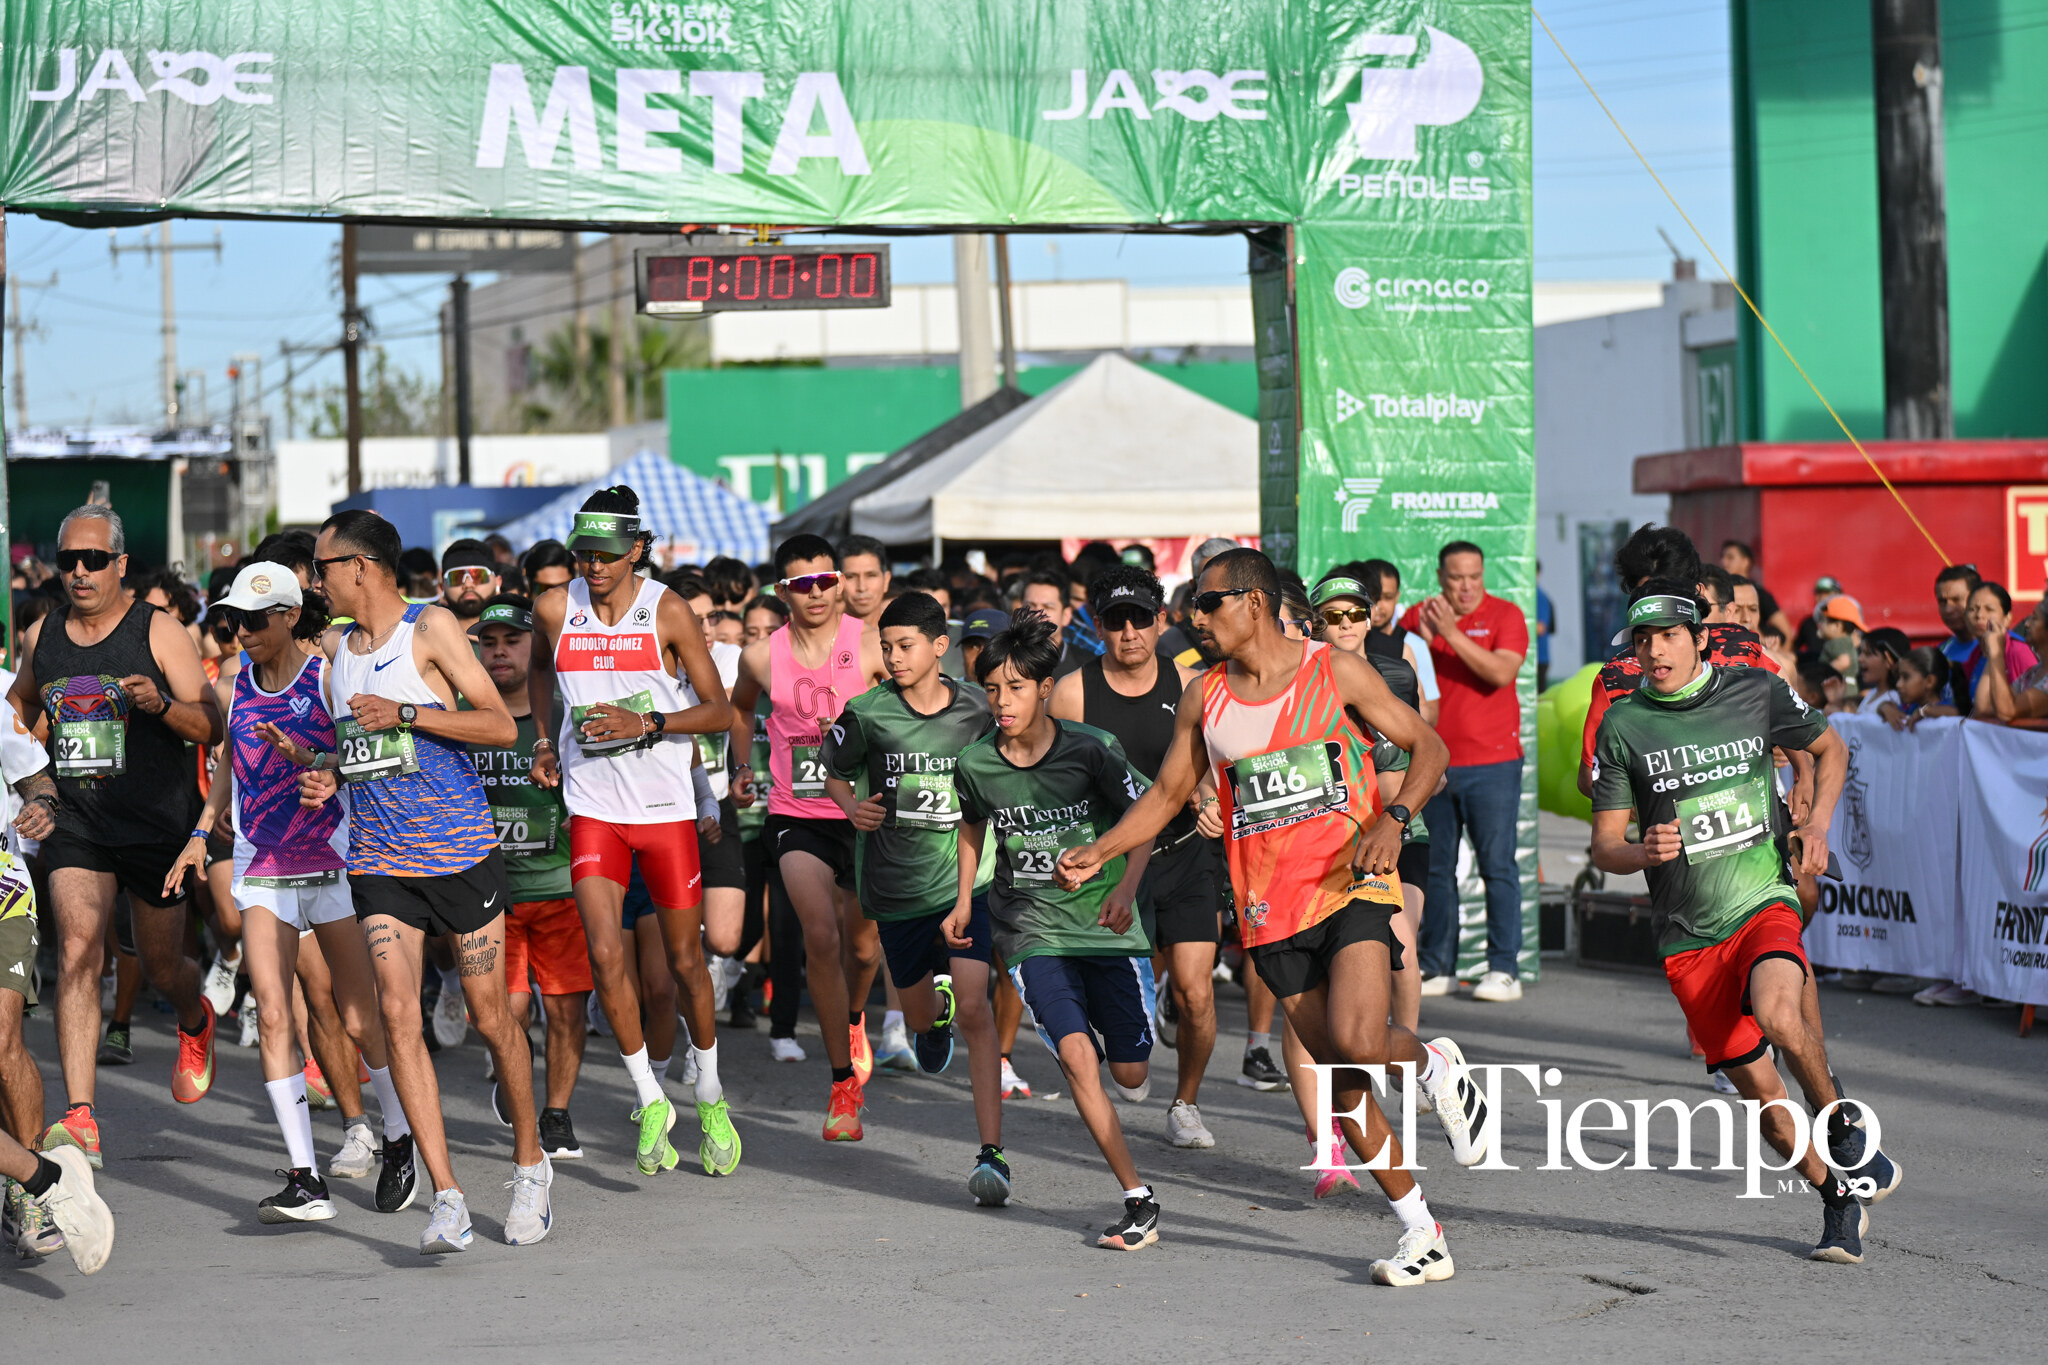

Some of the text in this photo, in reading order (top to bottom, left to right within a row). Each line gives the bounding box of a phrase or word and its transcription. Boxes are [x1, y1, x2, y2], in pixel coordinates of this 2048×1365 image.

[610, 2, 733, 20] CARRERA
[475, 63, 872, 177] META
[1369, 392, 1485, 425] Totalplay
[1391, 492, 1499, 510] FRONTERA
[569, 635, 643, 651] RODOLFO GÓMEZ
[593, 656, 615, 670] CLUB
[58, 736, 97, 760] 321
[115, 732, 123, 769] MEDALLA
[342, 733, 384, 765] 287
[788, 735, 820, 745] CHRISTIAN
[473, 750, 537, 771] El Tie
[884, 752, 958, 773] El Tiem
[1251, 751, 1287, 764] CARRERA
[1642, 735, 1764, 777] El Tiempo
[1249, 765, 1308, 801] 146
[1317, 753, 1335, 796] MEDALLA
[1652, 762, 1750, 793] de todos
[916, 789, 952, 814] 22
[1697, 789, 1736, 803] CARRERA
[994, 807, 1017, 829] El
[1691, 802, 1753, 841] 314
[1760, 790, 1771, 833] MEDALLA
[496, 821, 529, 842] 70
[549, 816, 557, 850] MEDALLA
[1232, 827, 1251, 840] CLUB
[1251, 822, 1277, 835] NORA
[1277, 811, 1316, 828] LETICIA
[1022, 834, 1058, 842] CARRERA
[1837, 924, 1861, 937] 2025
[1993, 901, 2048, 946] FRONT
[460, 931, 489, 953] Galvan
